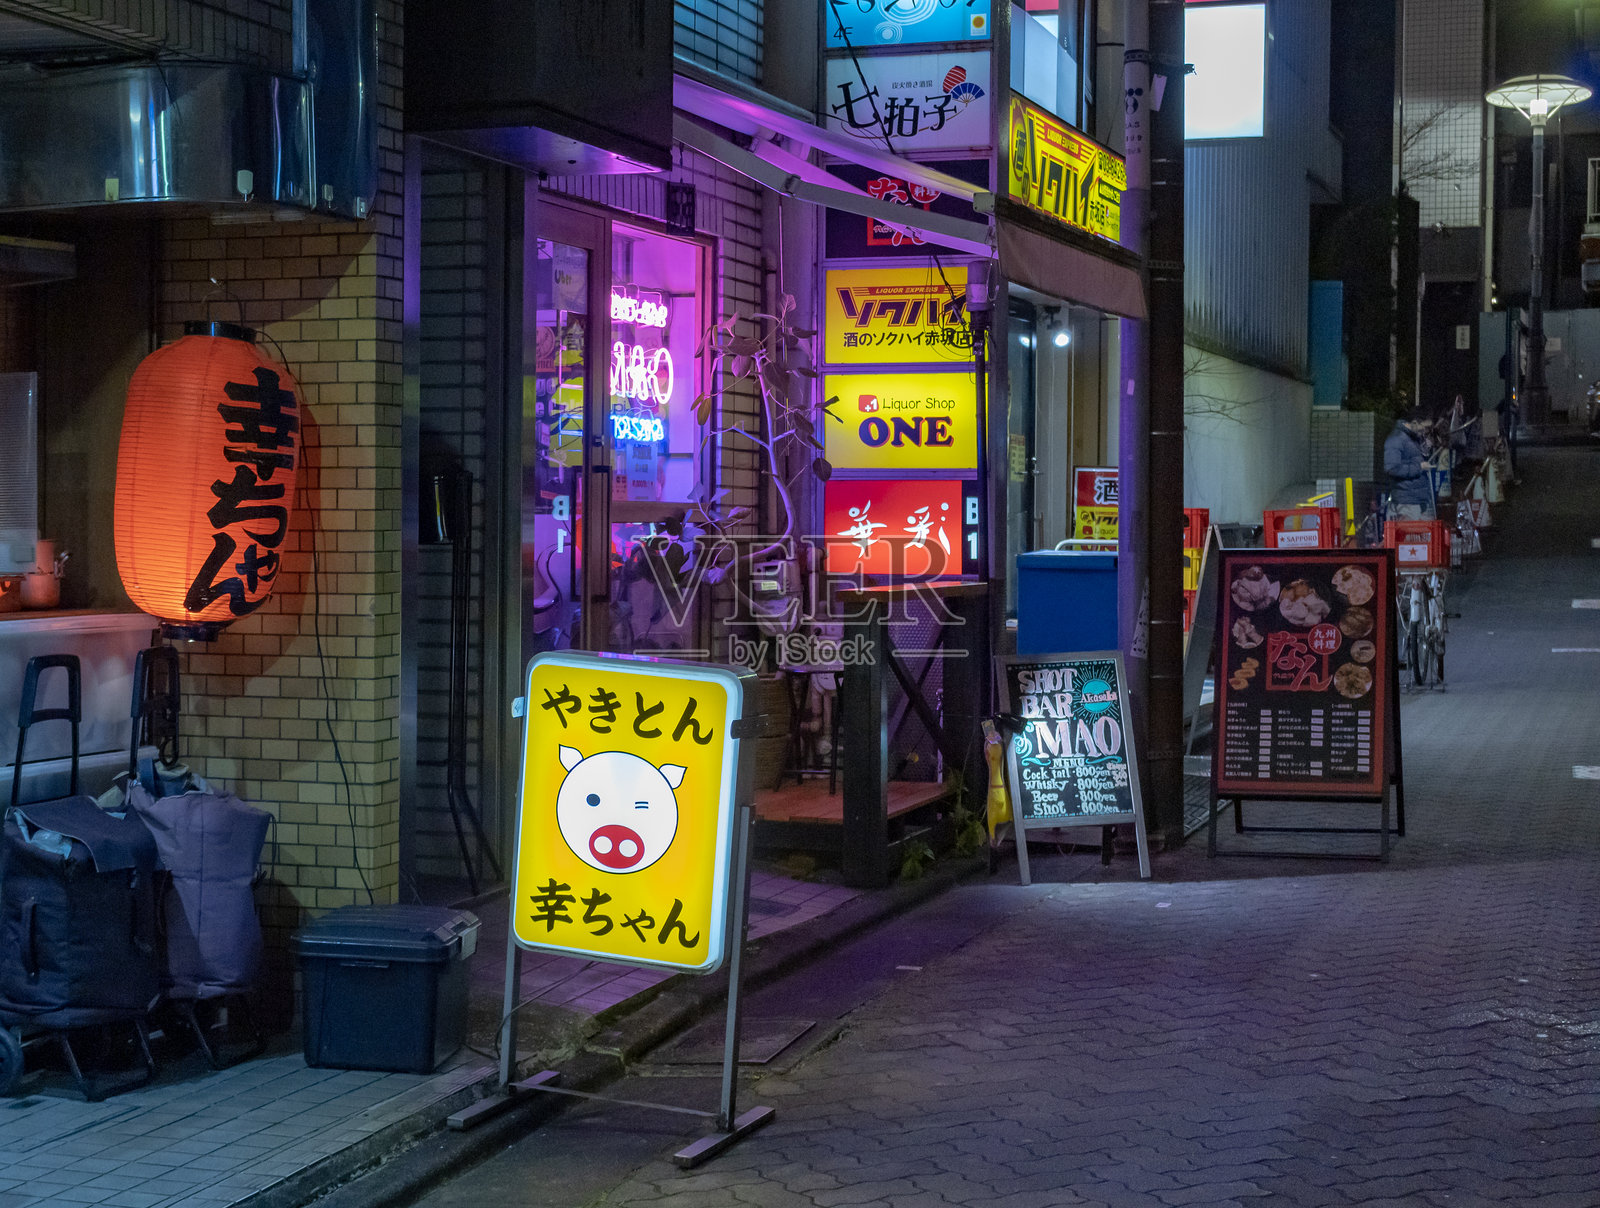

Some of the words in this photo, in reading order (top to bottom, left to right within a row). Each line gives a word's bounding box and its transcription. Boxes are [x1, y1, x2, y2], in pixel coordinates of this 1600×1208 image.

[832, 82, 957, 137] 七拍子
[882, 398, 921, 411] Liquor
[925, 397, 956, 411] Shop
[858, 416, 955, 448] ONE
[183, 366, 300, 617] 幸ちゃん
[1286, 535, 1317, 543] SAPPORO
[1313, 640, 1336, 650] 料理
[1314, 629, 1336, 638] 九州
[1268, 631, 1333, 692] なん
[1018, 668, 1077, 694] SHOT
[1019, 693, 1074, 718] BAR
[1080, 690, 1118, 703] Akasaka
[541, 684, 714, 745] やきとん
[1033, 716, 1121, 759] MAO
[1052, 758, 1085, 768] MENU
[1022, 780, 1069, 791] Whisky
[1033, 801, 1067, 815] Shot
[530, 878, 700, 949] 幸ちゃん
